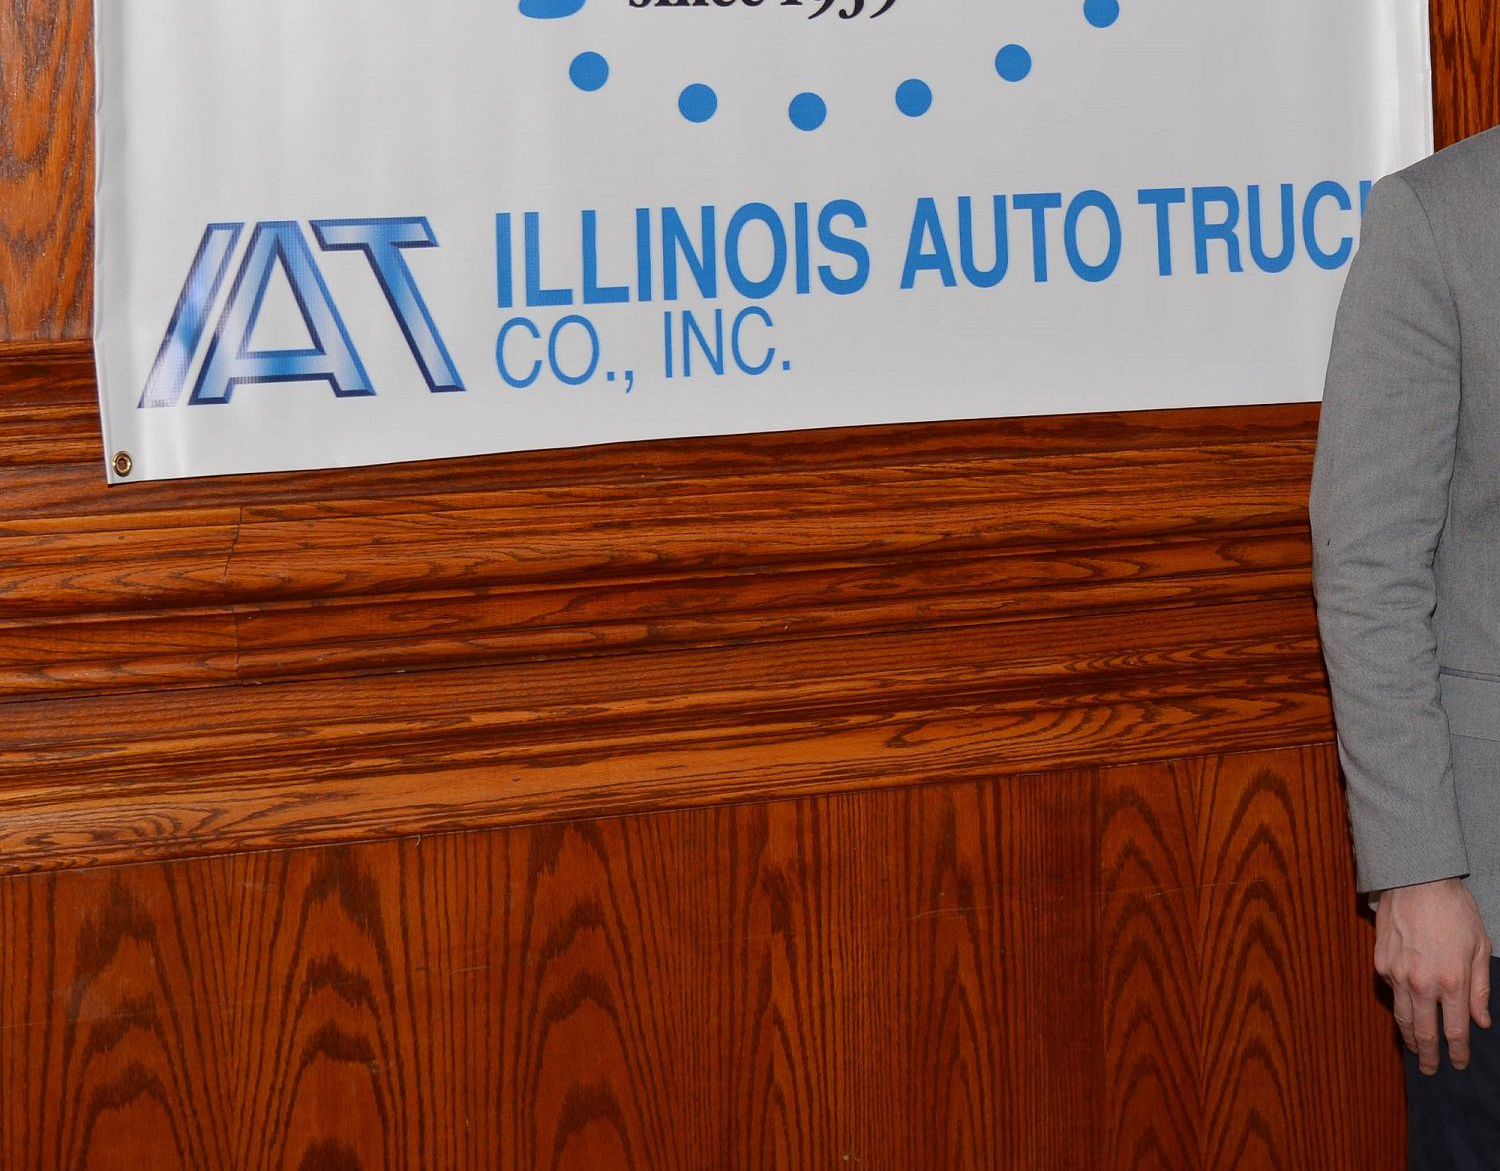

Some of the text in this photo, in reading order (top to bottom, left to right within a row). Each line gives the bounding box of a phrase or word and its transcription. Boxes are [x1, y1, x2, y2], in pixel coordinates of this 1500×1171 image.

[495, 179, 1374, 309] ILLINOIS AUTO TRUC
[495, 305, 792, 395] CO., INC.
